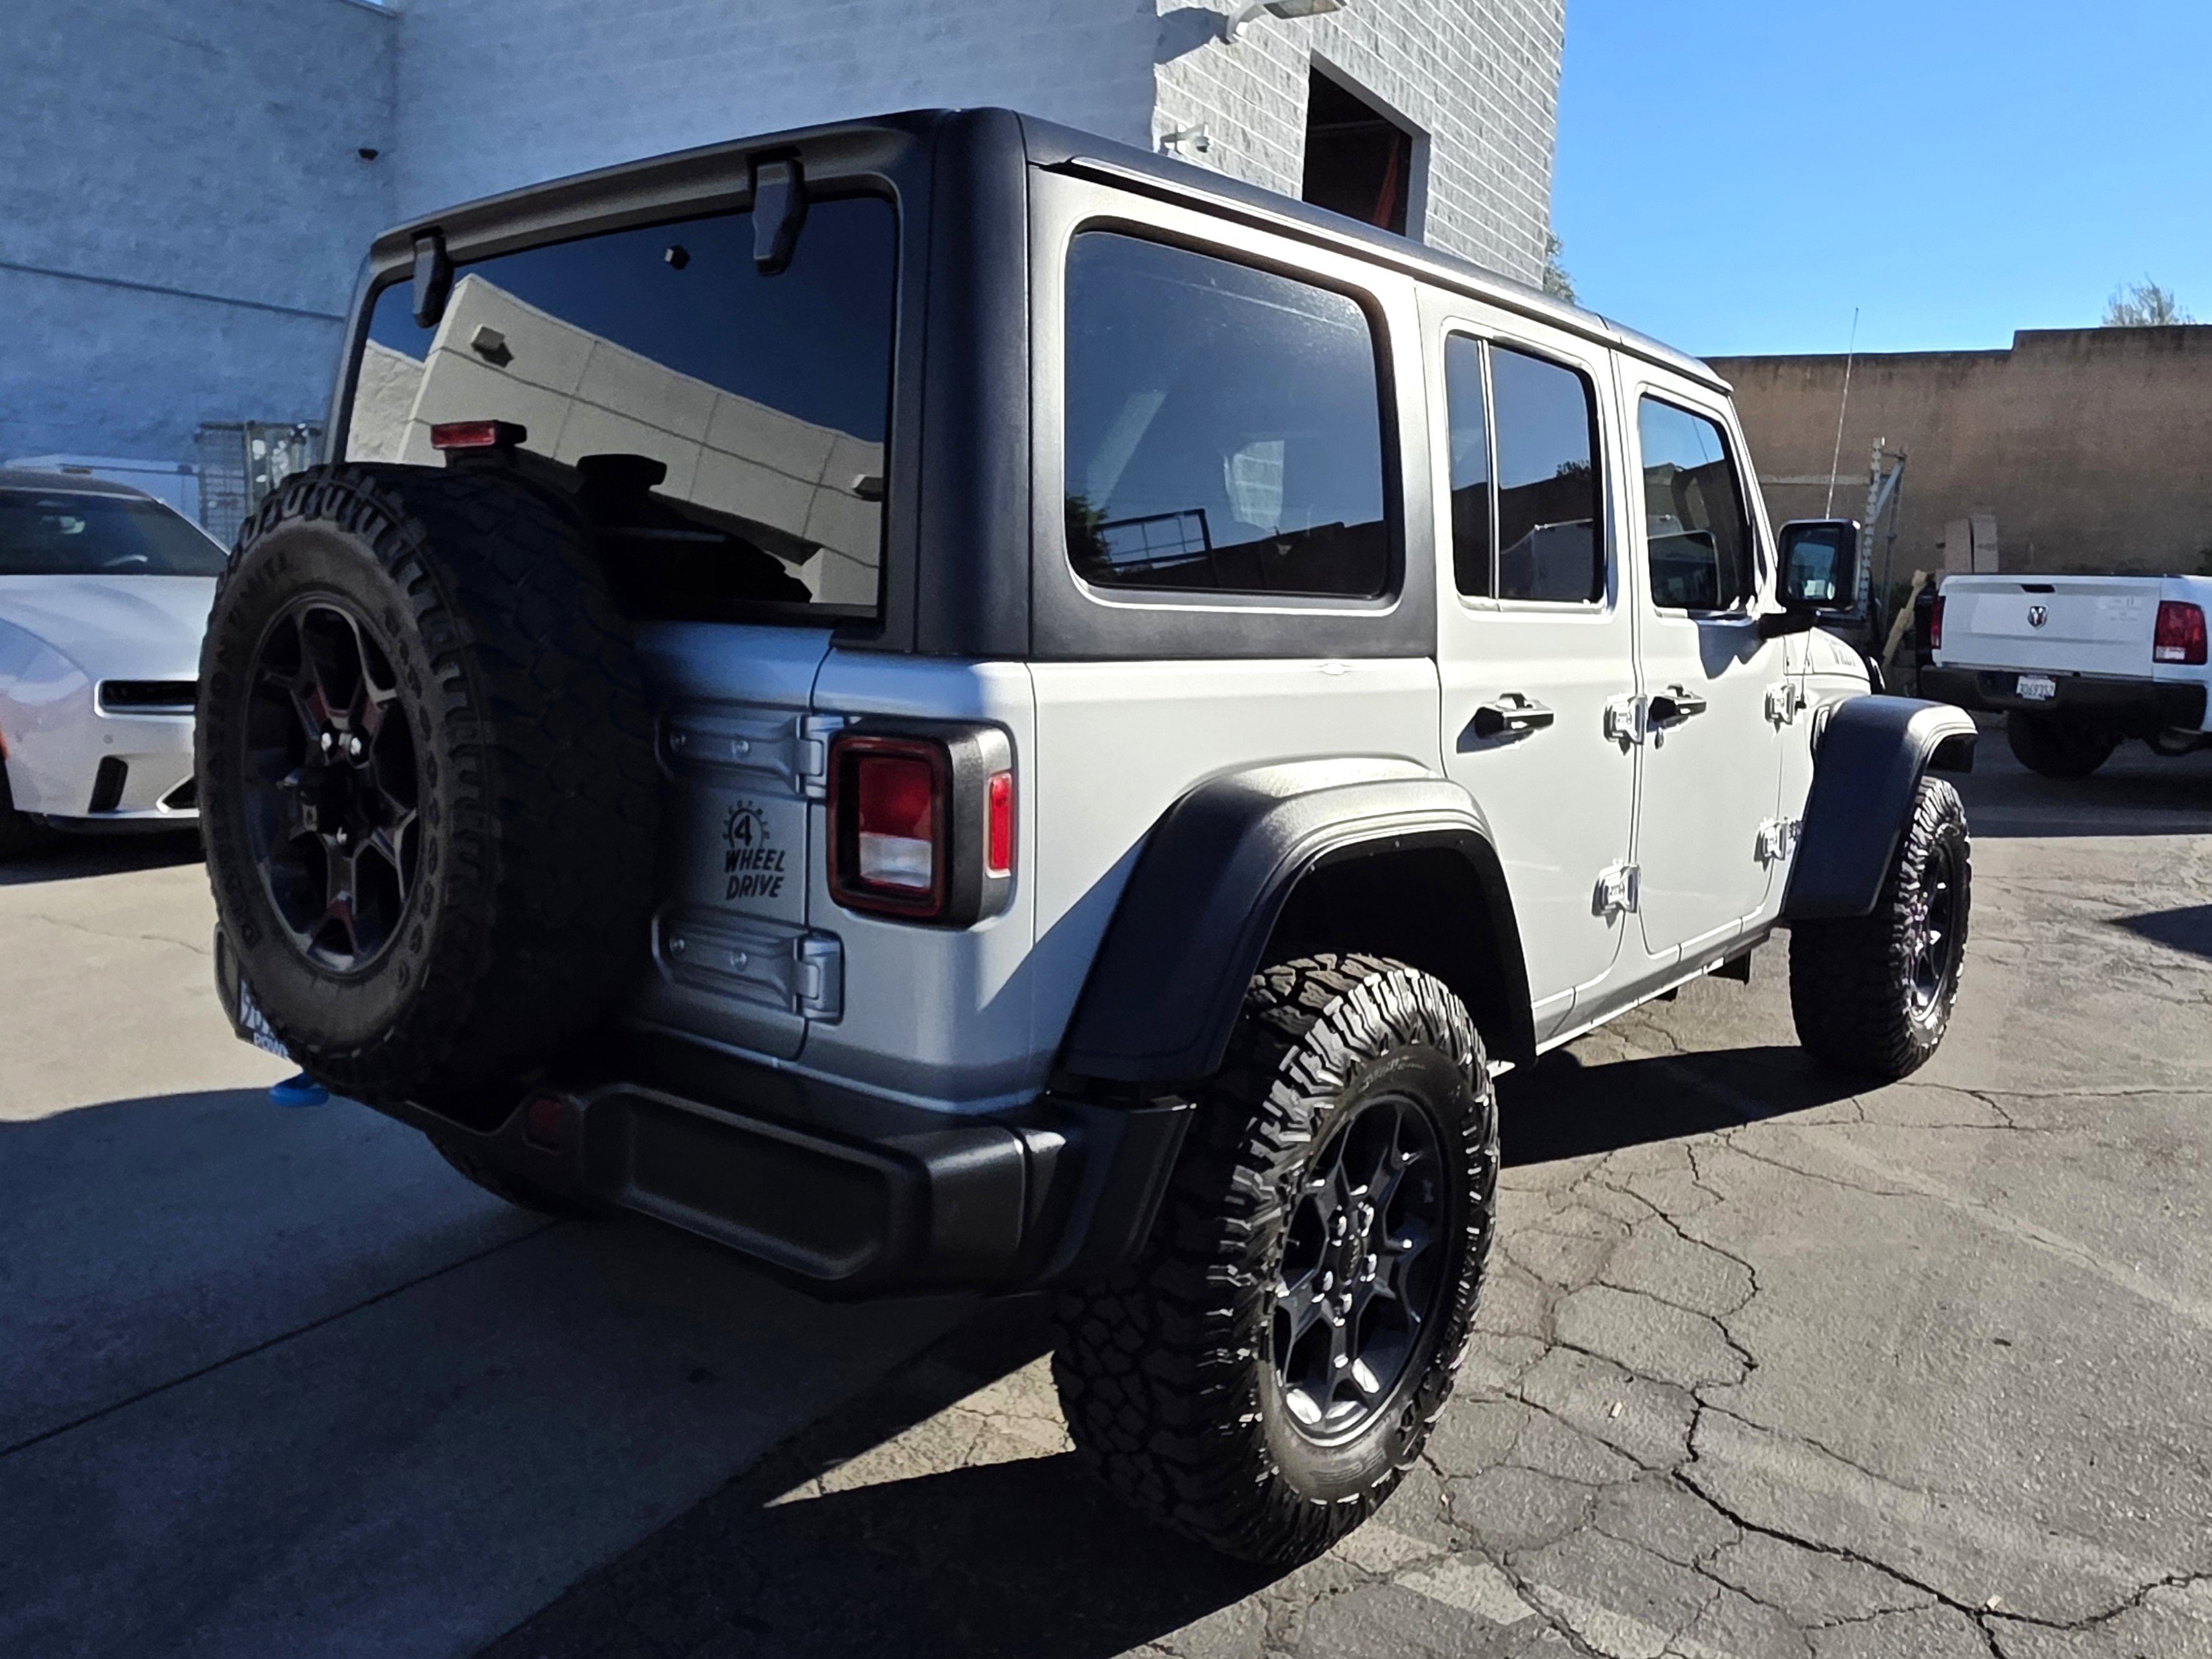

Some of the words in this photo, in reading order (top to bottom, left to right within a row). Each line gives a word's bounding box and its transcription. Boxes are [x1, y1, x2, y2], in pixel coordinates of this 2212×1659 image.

[734, 814, 752, 847] 4
[725, 849, 785, 873] WHEEL
[726, 874, 785, 901] DRIVE
